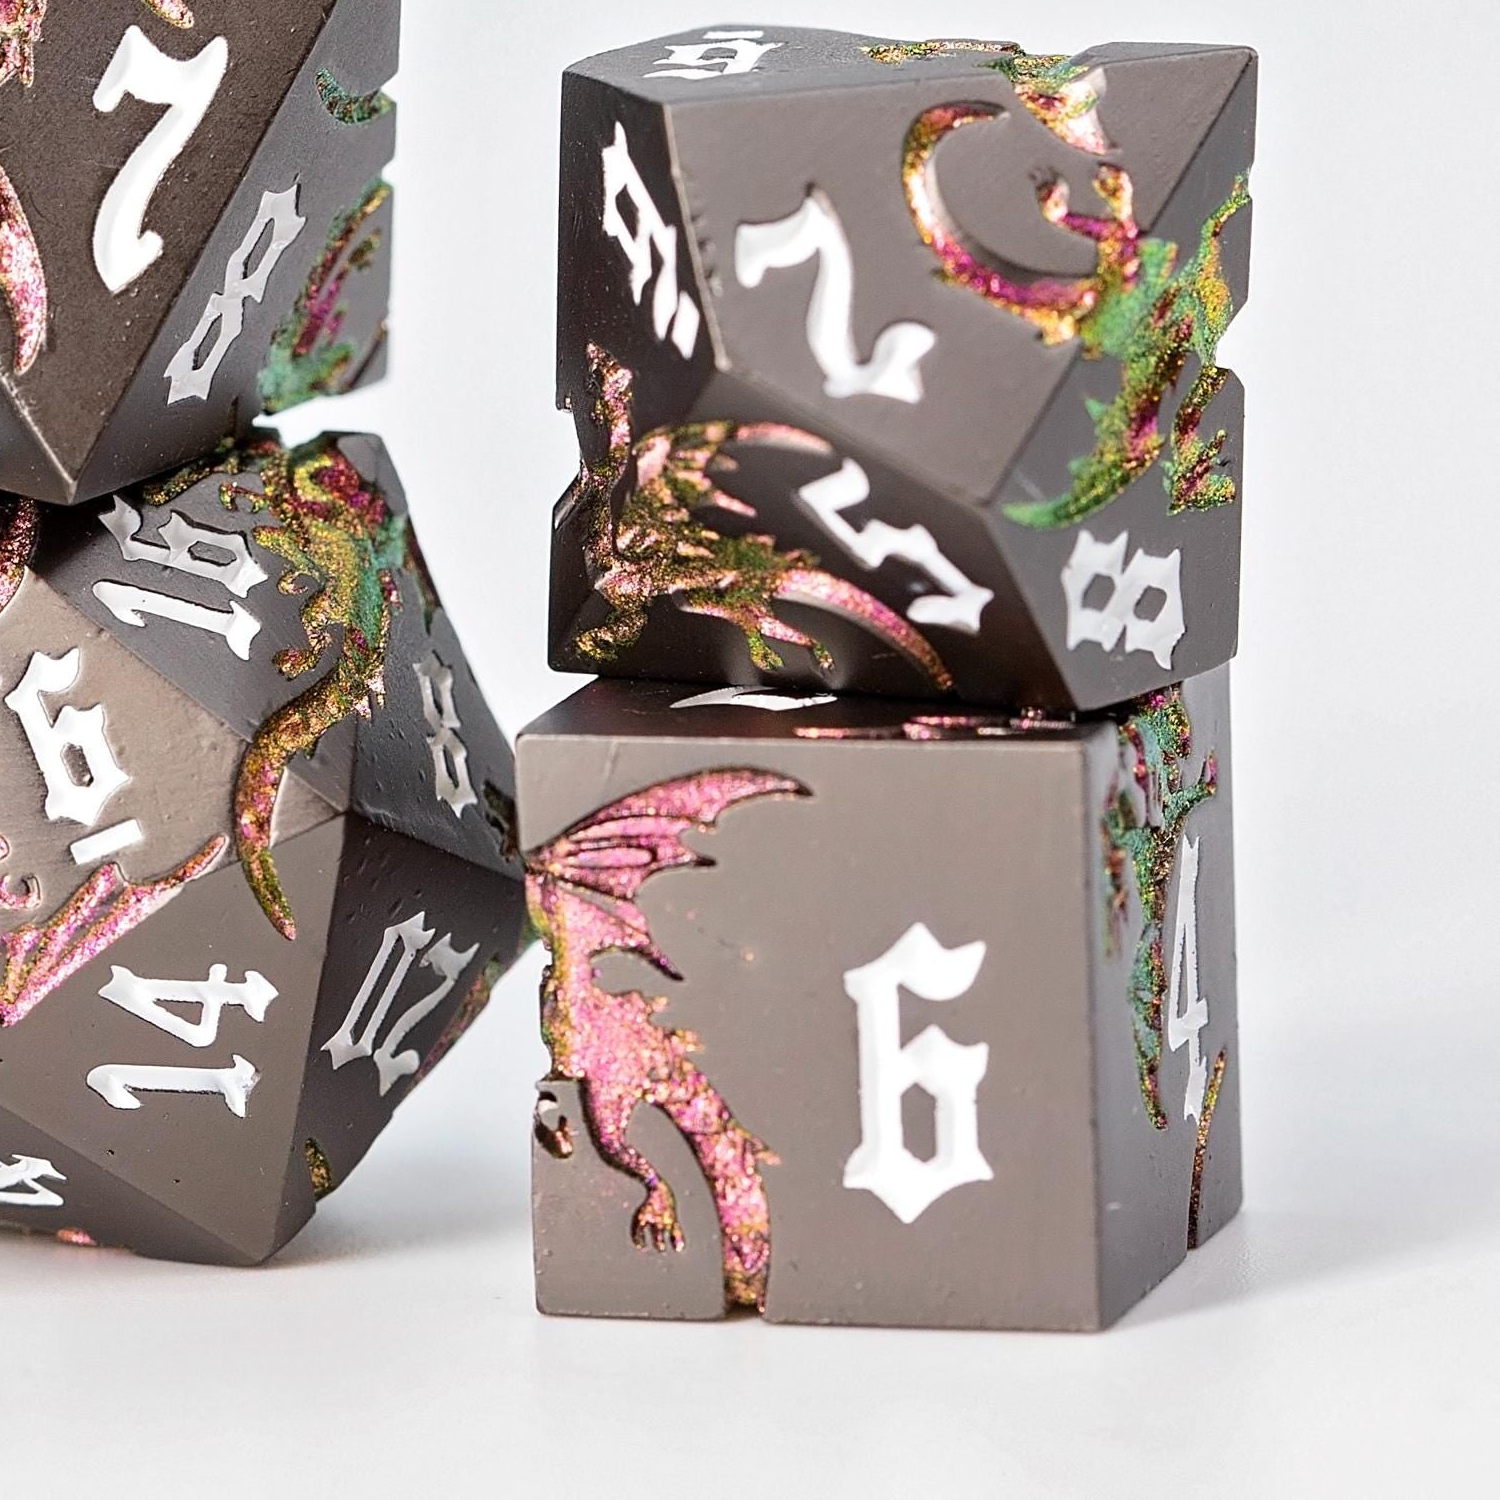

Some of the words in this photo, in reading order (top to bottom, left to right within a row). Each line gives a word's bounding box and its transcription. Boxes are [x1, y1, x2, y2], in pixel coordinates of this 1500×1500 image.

[92, 24, 229, 293] 7
[162, 181, 306, 405] 8
[94, 495, 272, 662] 16
[1060, 528, 1187, 670] 8
[410, 652, 480, 820] 8
[86, 961, 281, 1119] 14
[841, 921, 995, 1226] 6
[1167, 832, 1210, 1125] 4
